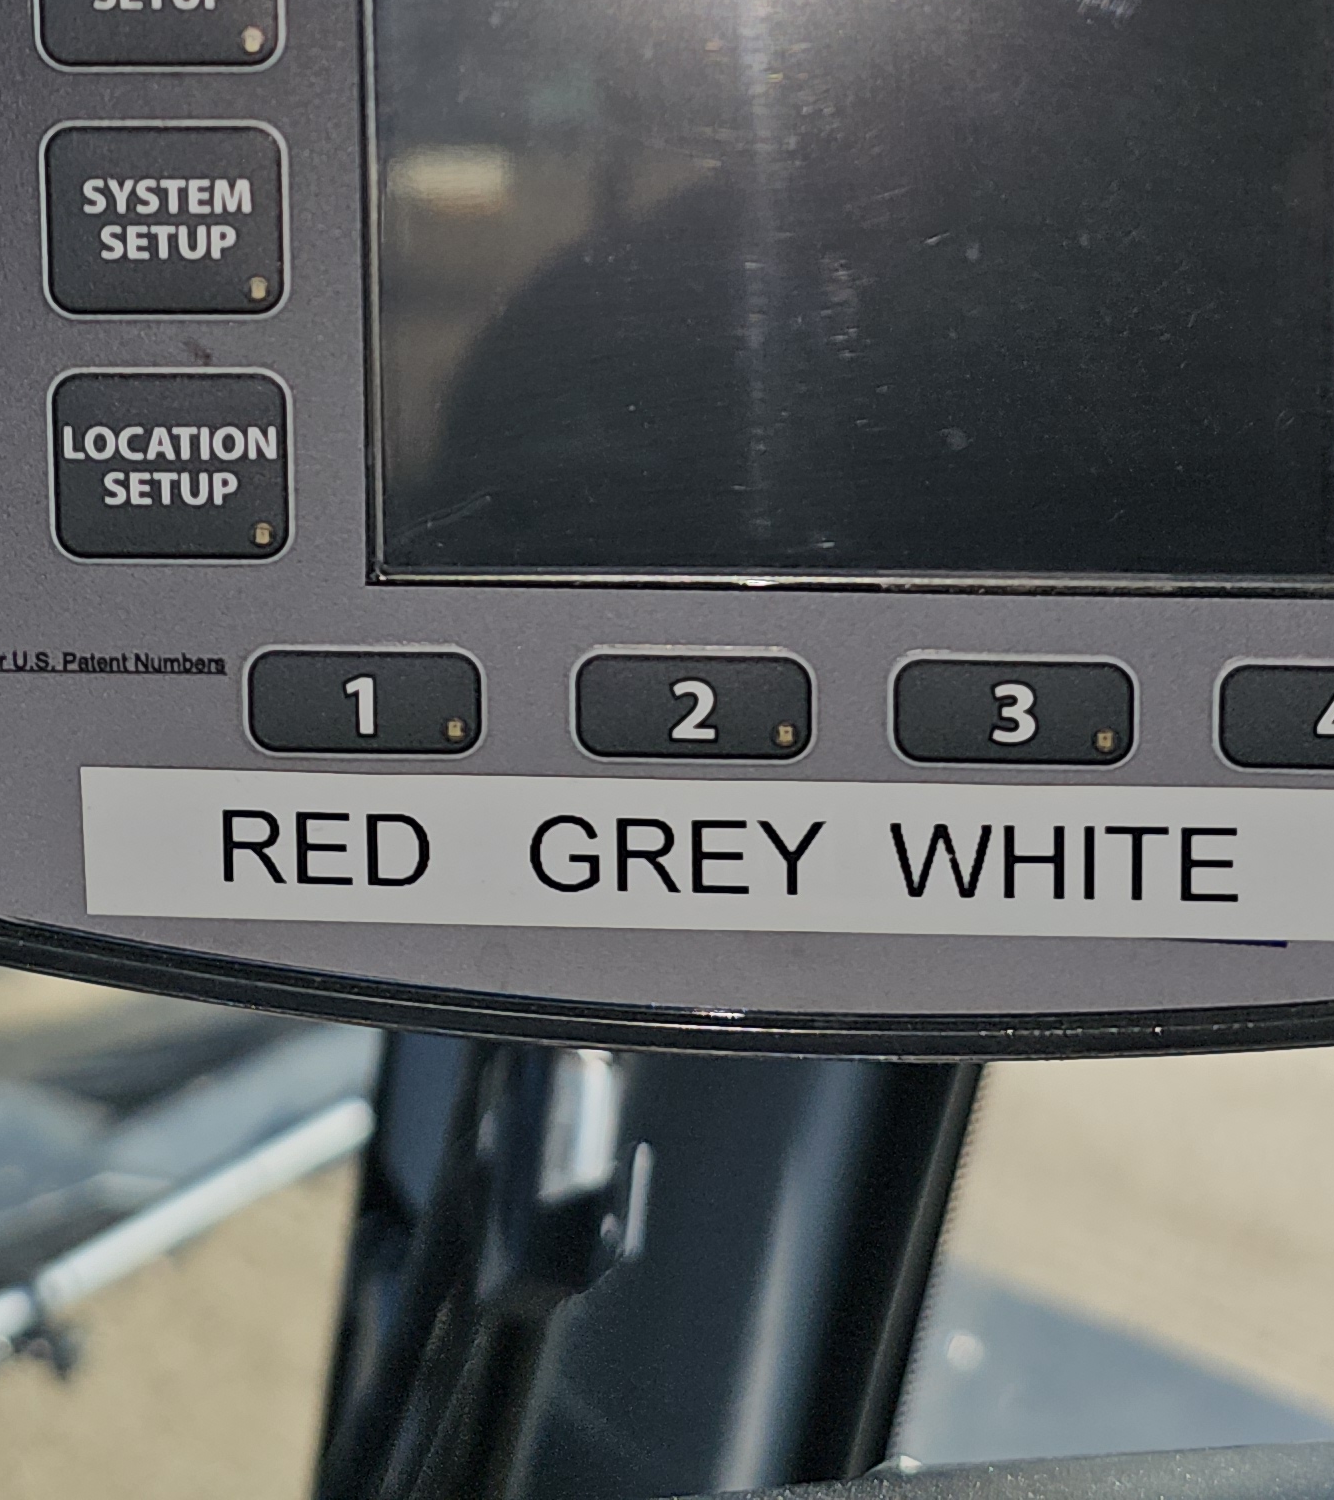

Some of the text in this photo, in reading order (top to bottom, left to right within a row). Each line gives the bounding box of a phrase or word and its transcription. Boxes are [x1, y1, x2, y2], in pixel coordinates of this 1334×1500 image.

[81, 177, 253, 215] SYSTEM
[99, 224, 238, 261] SETUP
[63, 424, 279, 462] LOCATION
[102, 471, 239, 507] SETUP
[12, 651, 56, 672] U.S.
[63, 652, 128, 673] Patent
[134, 654, 227, 674] Numbers
[345, 675, 375, 736] 1
[670, 680, 717, 741] 2
[991, 682, 1037, 744] 3
[221, 808, 1241, 904] RED GREY WHITE
